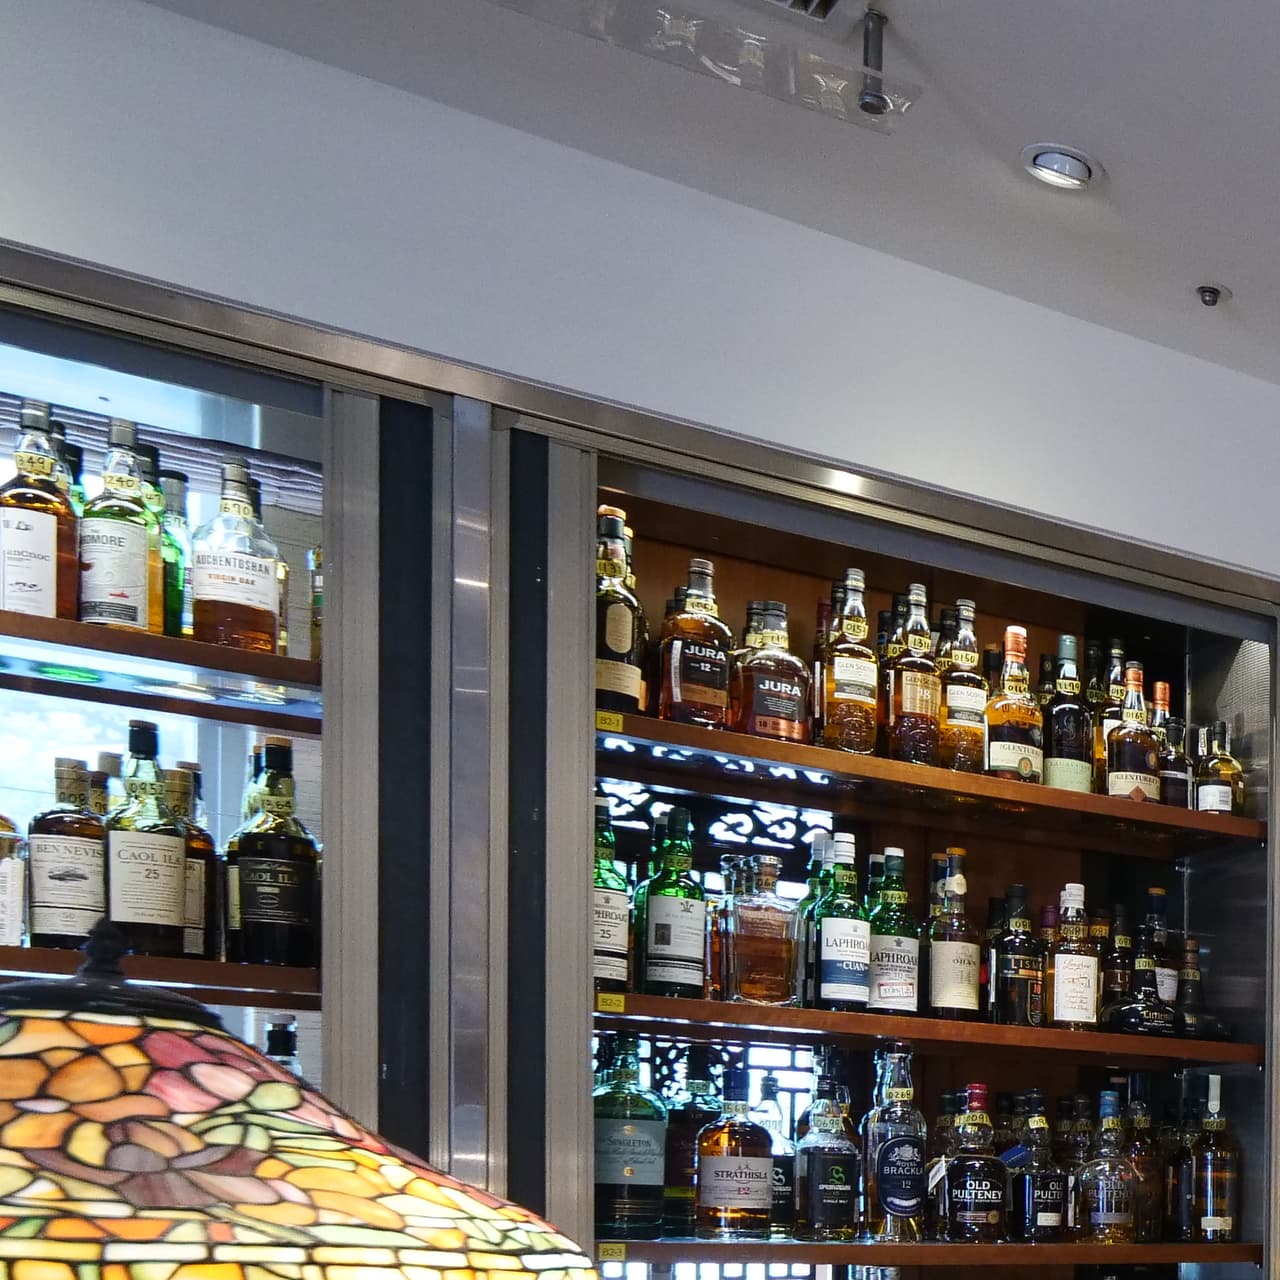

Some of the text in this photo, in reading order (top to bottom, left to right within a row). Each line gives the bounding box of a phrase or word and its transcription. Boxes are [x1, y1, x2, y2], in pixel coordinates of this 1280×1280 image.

[685, 645, 726, 662] JURA
[700, 662, 711, 672] 12
[759, 679, 802, 697] JURA
[117, 849, 160, 863] CAOL
[144, 868, 160, 880] 25
[599, 929, 612, 939] 25
[966, 1180, 990, 1191] OLD
[952, 1189, 1003, 1200] PULTENEY
